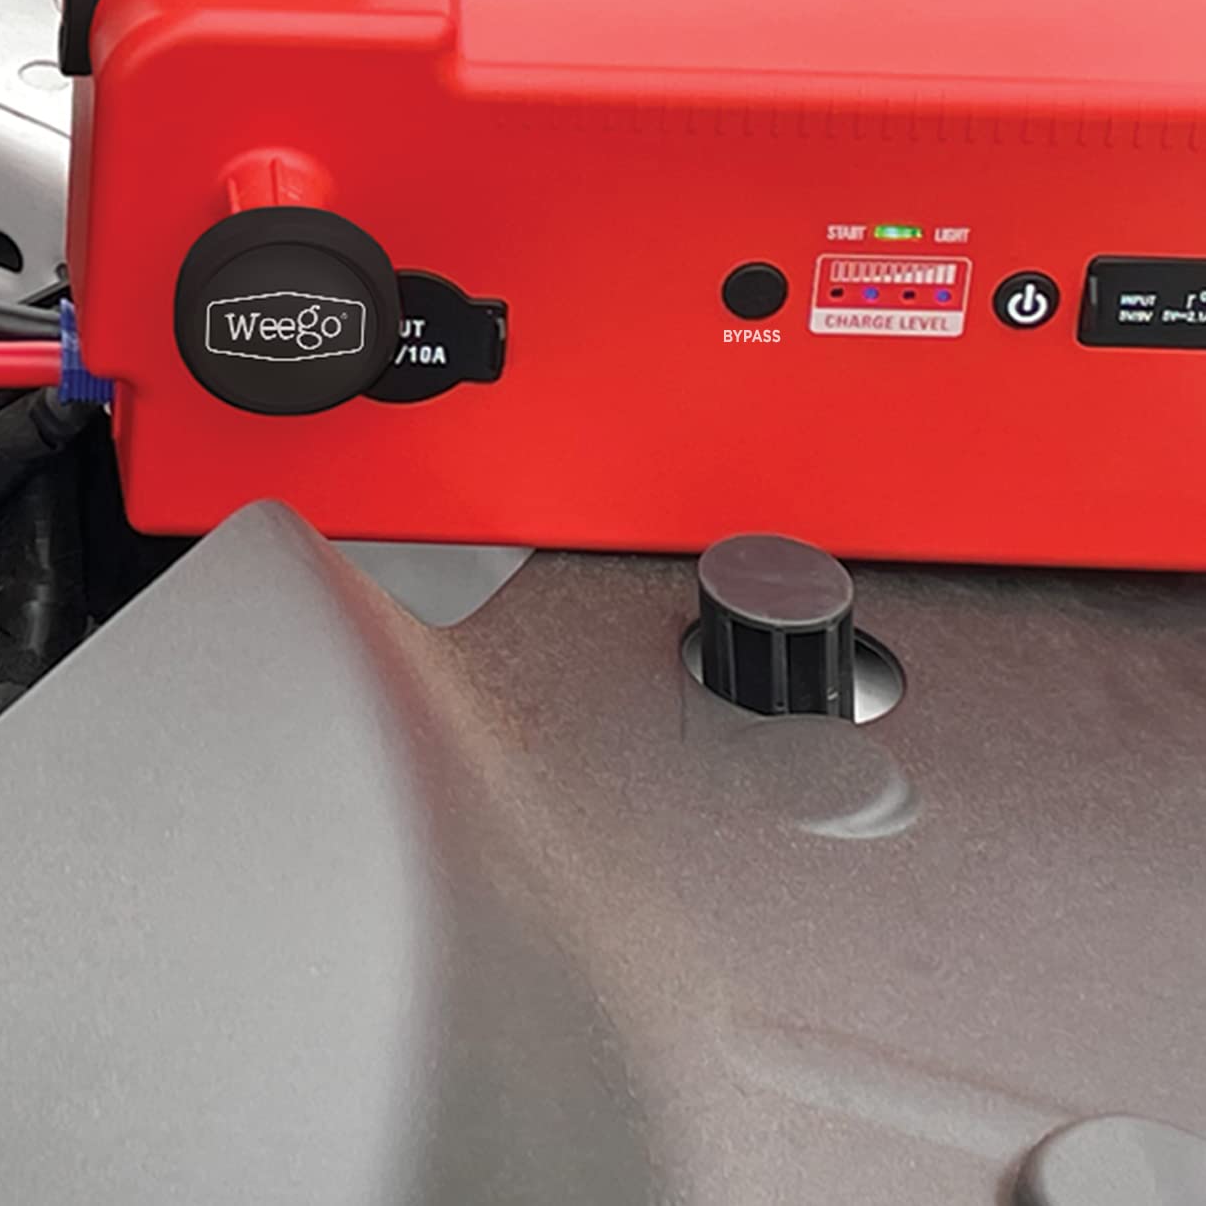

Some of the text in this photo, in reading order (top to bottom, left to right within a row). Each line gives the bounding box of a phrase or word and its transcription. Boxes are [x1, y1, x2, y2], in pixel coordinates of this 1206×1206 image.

[826, 224, 867, 240] START
[933, 227, 971, 243] LIGHT
[224, 305, 343, 350] Weego
[824, 313, 949, 331] CHARGE LEVEL
[722, 329, 782, 343] BYPASS
